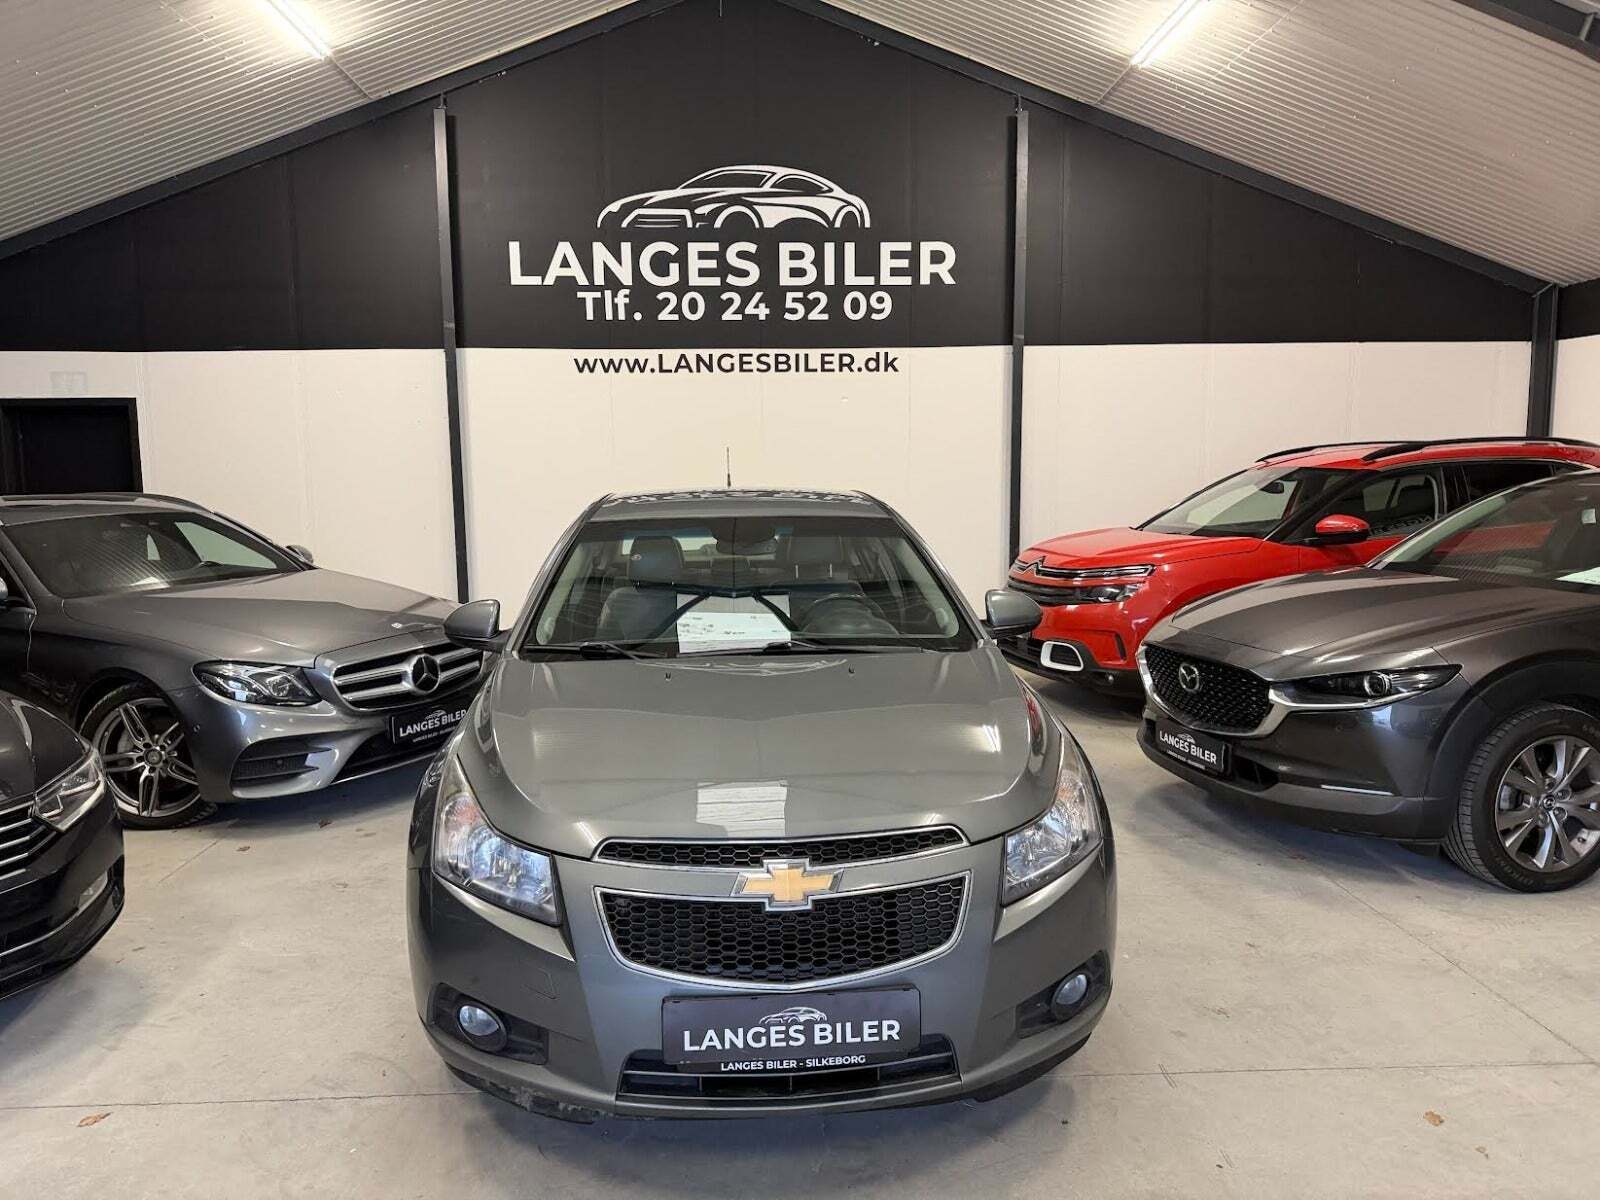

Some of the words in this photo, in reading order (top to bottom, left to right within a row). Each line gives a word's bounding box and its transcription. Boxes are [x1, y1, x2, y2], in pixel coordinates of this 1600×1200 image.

[508, 240, 761, 286] LANGES
[778, 240, 957, 286] BILER
[576, 288, 643, 321] Tlf.
[656, 291, 706, 321] 20
[720, 291, 770, 321] 24
[783, 291, 829, 321] 52
[843, 290, 893, 321] 09
[573, 351, 899, 374] www.LANGESBILER.dk
[399, 717, 441, 737] LANGES
[1159, 730, 1190, 753] LANGES
[1190, 744, 1217, 765] BILER
[683, 1024, 806, 1052] LANGES
[813, 1019, 901, 1045] BILER
[721, 1060, 764, 1072] LANGES
[766, 1060, 798, 1070] BILER
[805, 1054, 866, 1068] SILKEBORG
